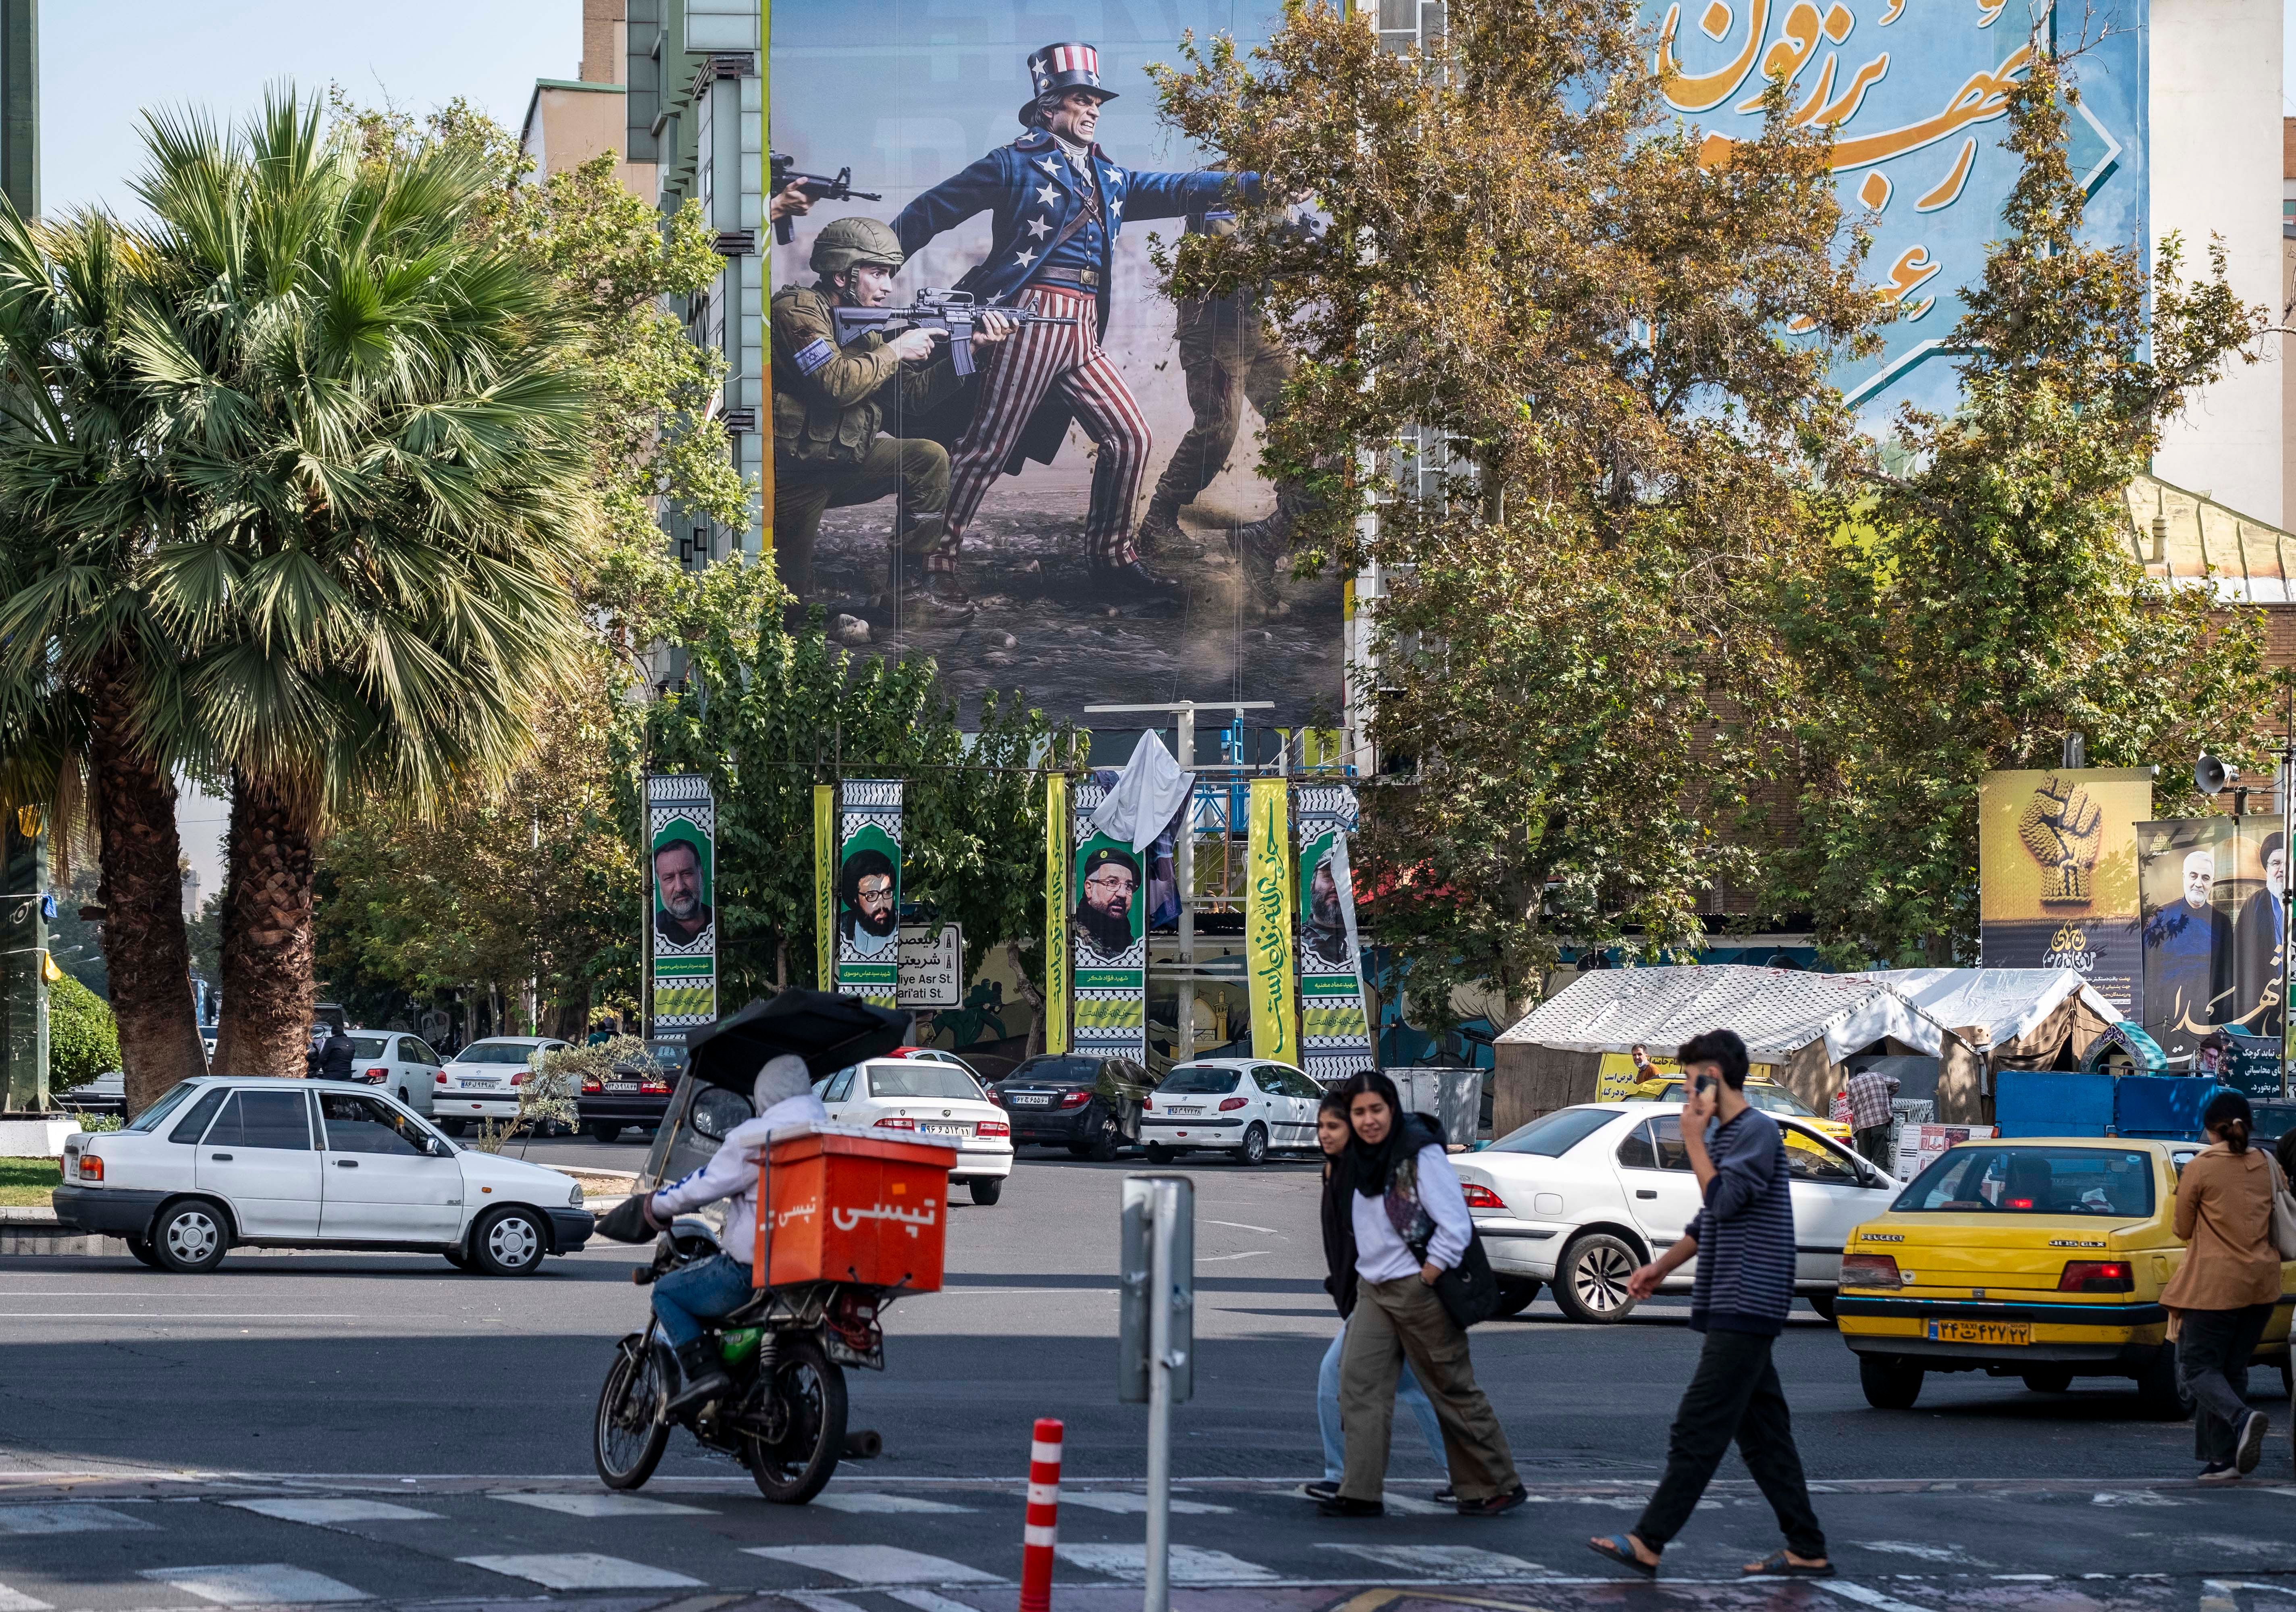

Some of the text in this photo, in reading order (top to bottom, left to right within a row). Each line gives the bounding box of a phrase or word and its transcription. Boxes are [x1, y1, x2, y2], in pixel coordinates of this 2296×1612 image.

[919, 974, 936, 984] Asr
[939, 974, 953, 984] St.
[898, 988, 944, 999] ari'ati St.
[2242, 1048, 2261, 1059] کوچک
[2261, 1048, 2275, 1059] نباید
[2244, 1065, 2270, 1076] محاسباتی
[1604, 1072, 1617, 1081] است
[1617, 1072, 1633, 1083] فرض
[832, 1199, 936, 1238] تپسی
[1861, 1234, 1905, 1242] PEUGEOT
